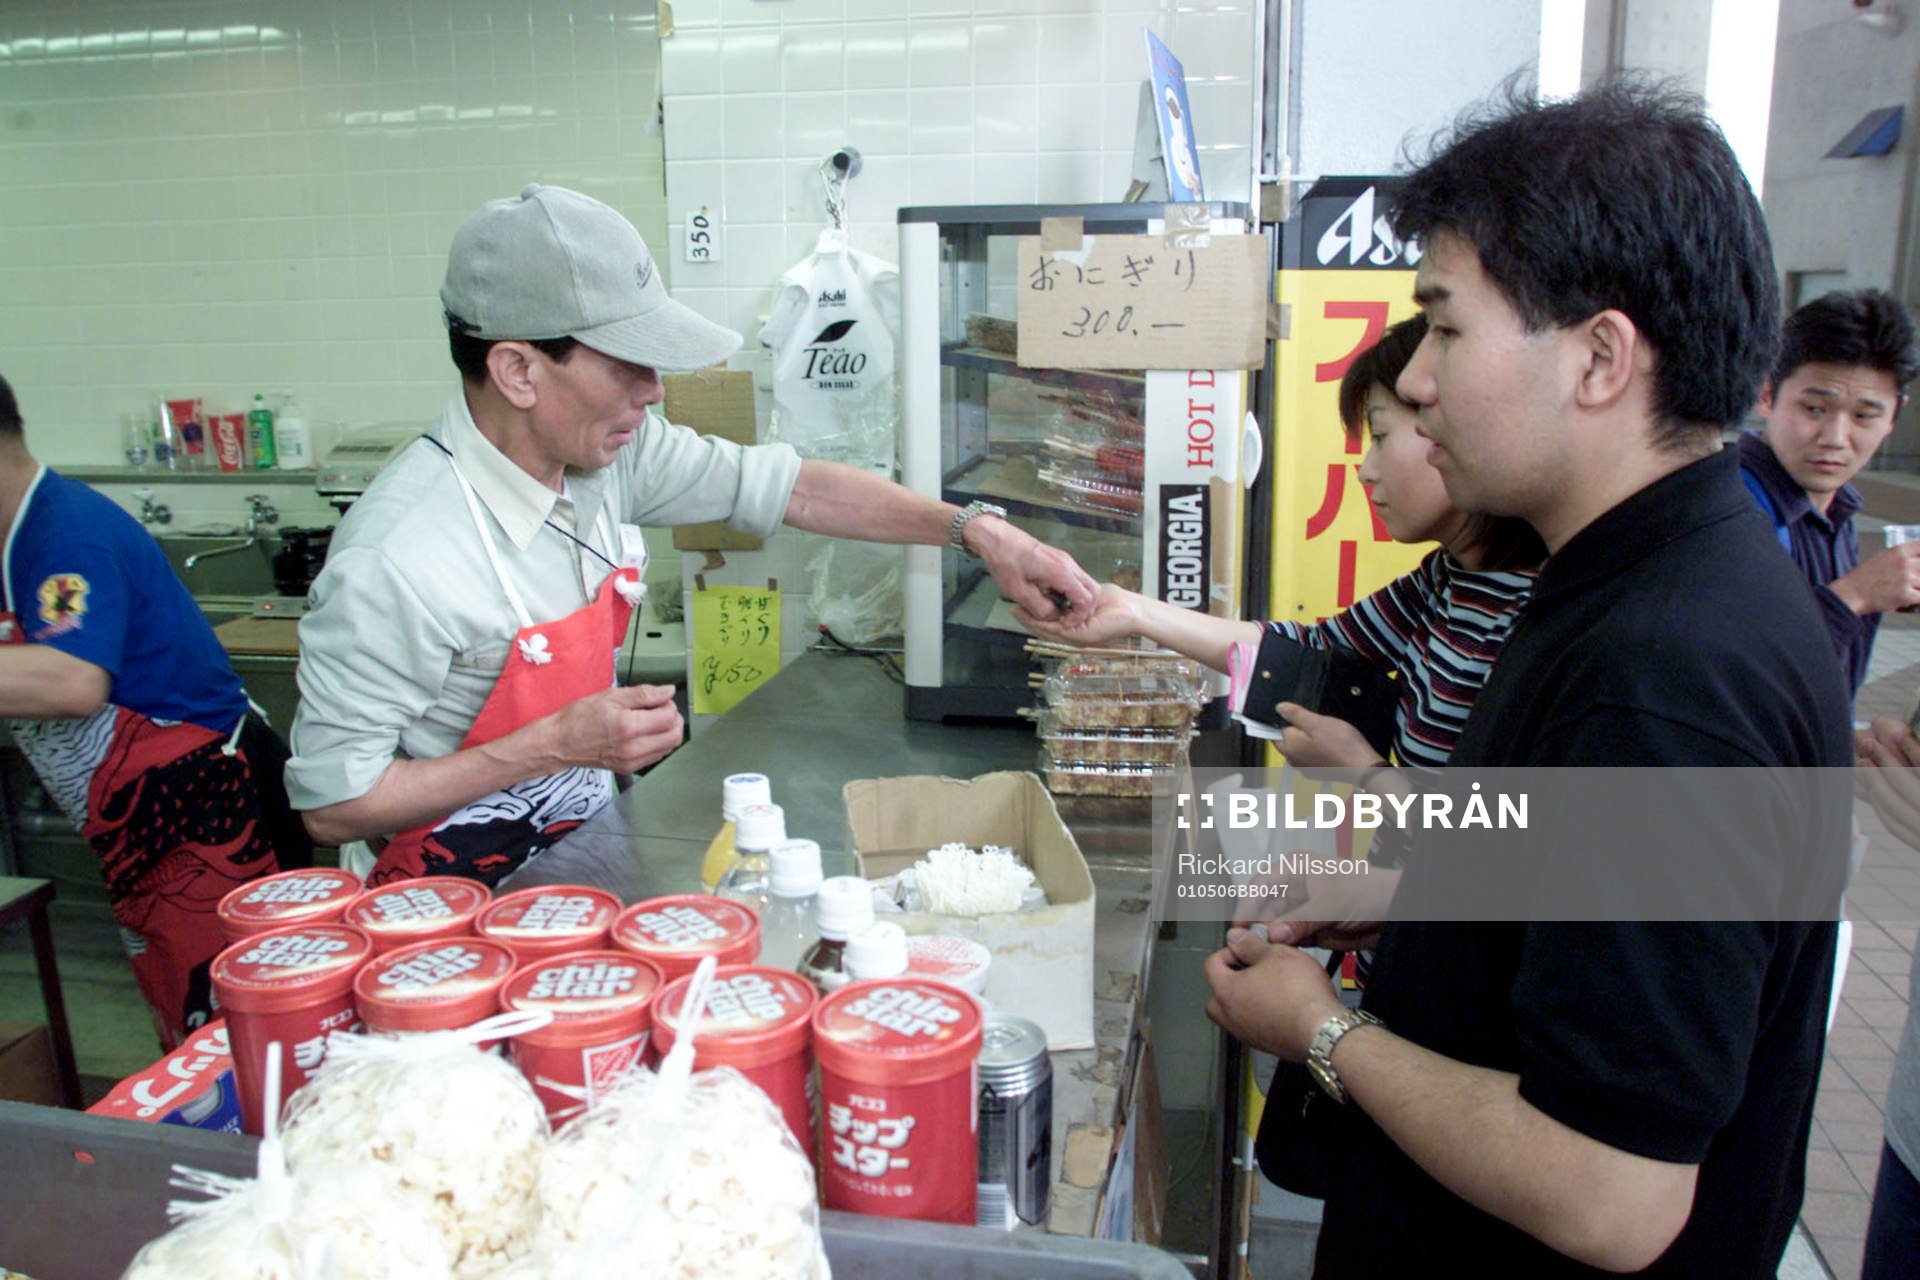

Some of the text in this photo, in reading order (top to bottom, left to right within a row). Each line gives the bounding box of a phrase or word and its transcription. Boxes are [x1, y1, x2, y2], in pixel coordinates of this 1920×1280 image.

[691, 215, 710, 257] 350
[1030, 250, 1196, 292] おにぎり
[801, 348, 867, 380] Teao
[1187, 399, 1215, 468] HOT
[1167, 493, 1203, 608] GEORGIA
[241, 889, 331, 904] star
[259, 877, 344, 892] chip
[236, 949, 333, 968] star
[258, 935, 349, 953] chip
[526, 979, 632, 999] star
[536, 963, 638, 984] chip
[842, 998, 940, 1037] star
[868, 987, 962, 1023] chip
[829, 1103, 915, 1148] チップ
[832, 1136, 910, 1178] スター
